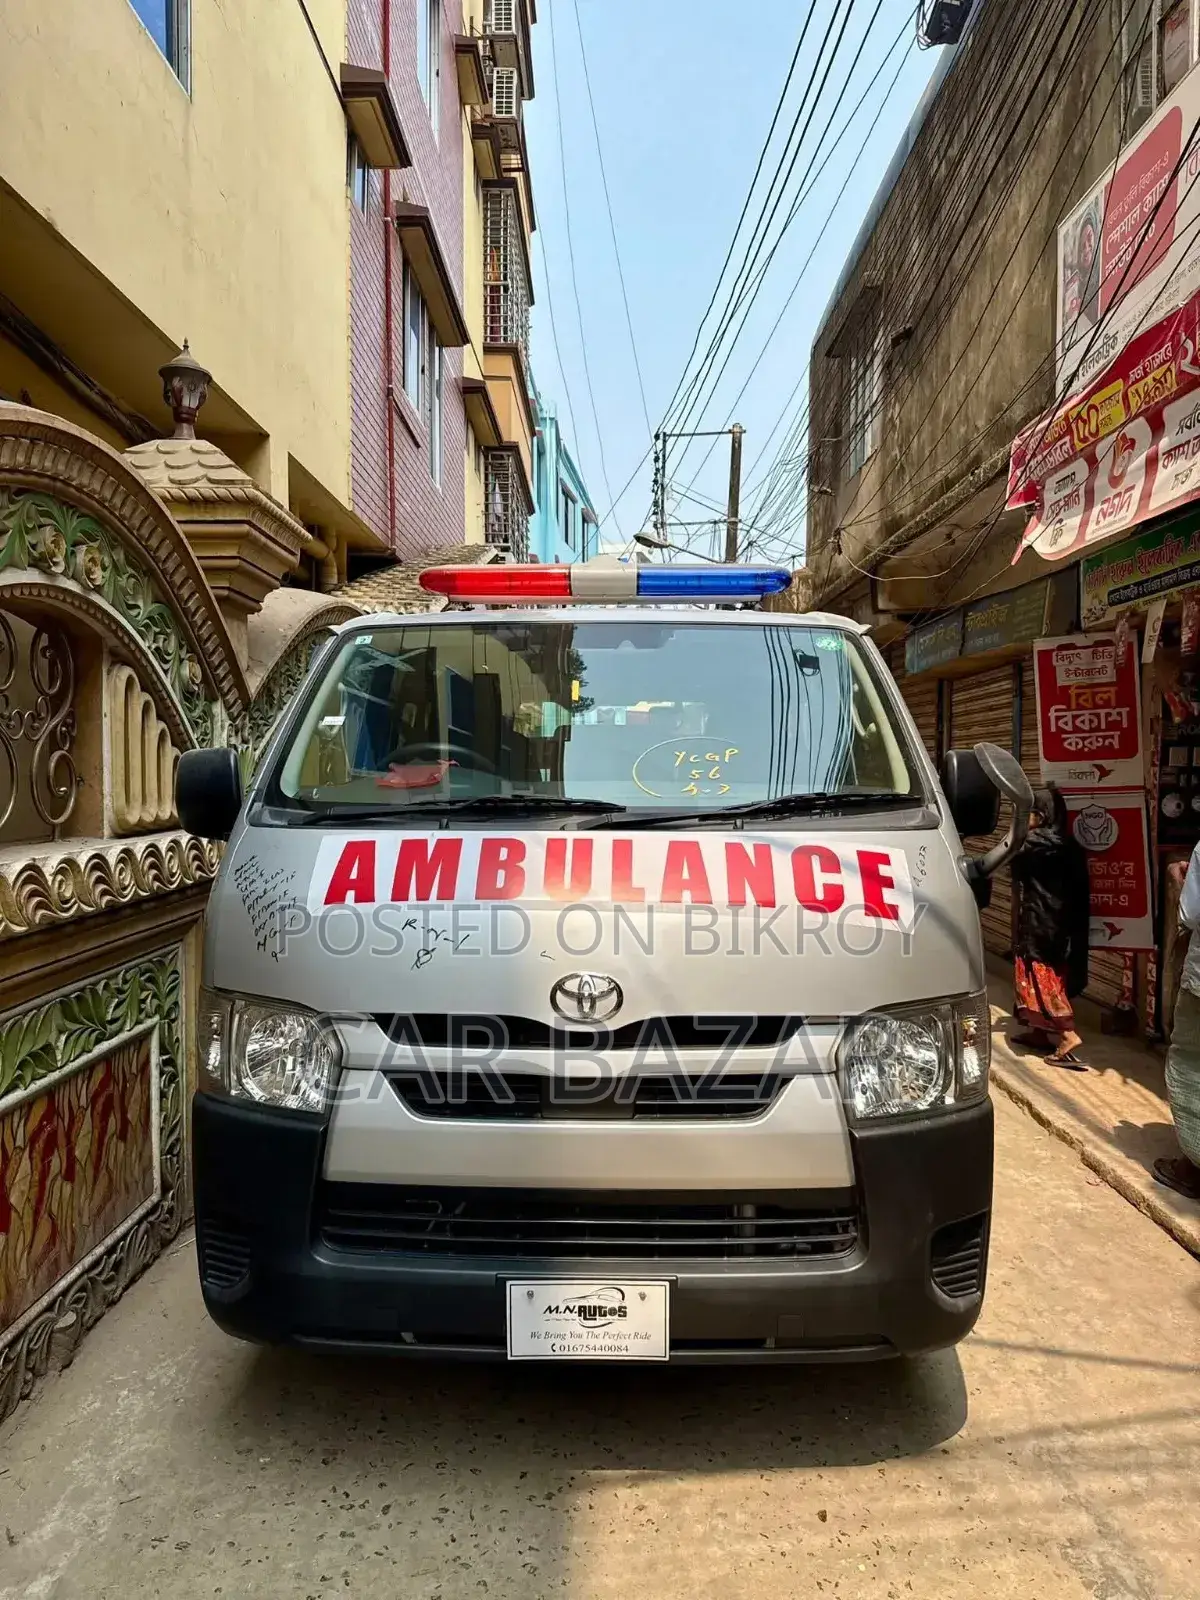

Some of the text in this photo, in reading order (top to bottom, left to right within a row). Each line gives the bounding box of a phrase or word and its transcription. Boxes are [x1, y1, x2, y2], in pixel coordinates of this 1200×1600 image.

[1068, 683, 1119, 710] বিল
[1048, 704, 1130, 733] বিকাশ
[1061, 731, 1121, 752] করুন
[1085, 811, 1105, 820] NGO
[323, 837, 900, 921] AMBULANCE
[530, 1330, 652, 1341] We Bring You The Perfect Ride
[559, 1343, 630, 1354] 01675440084
